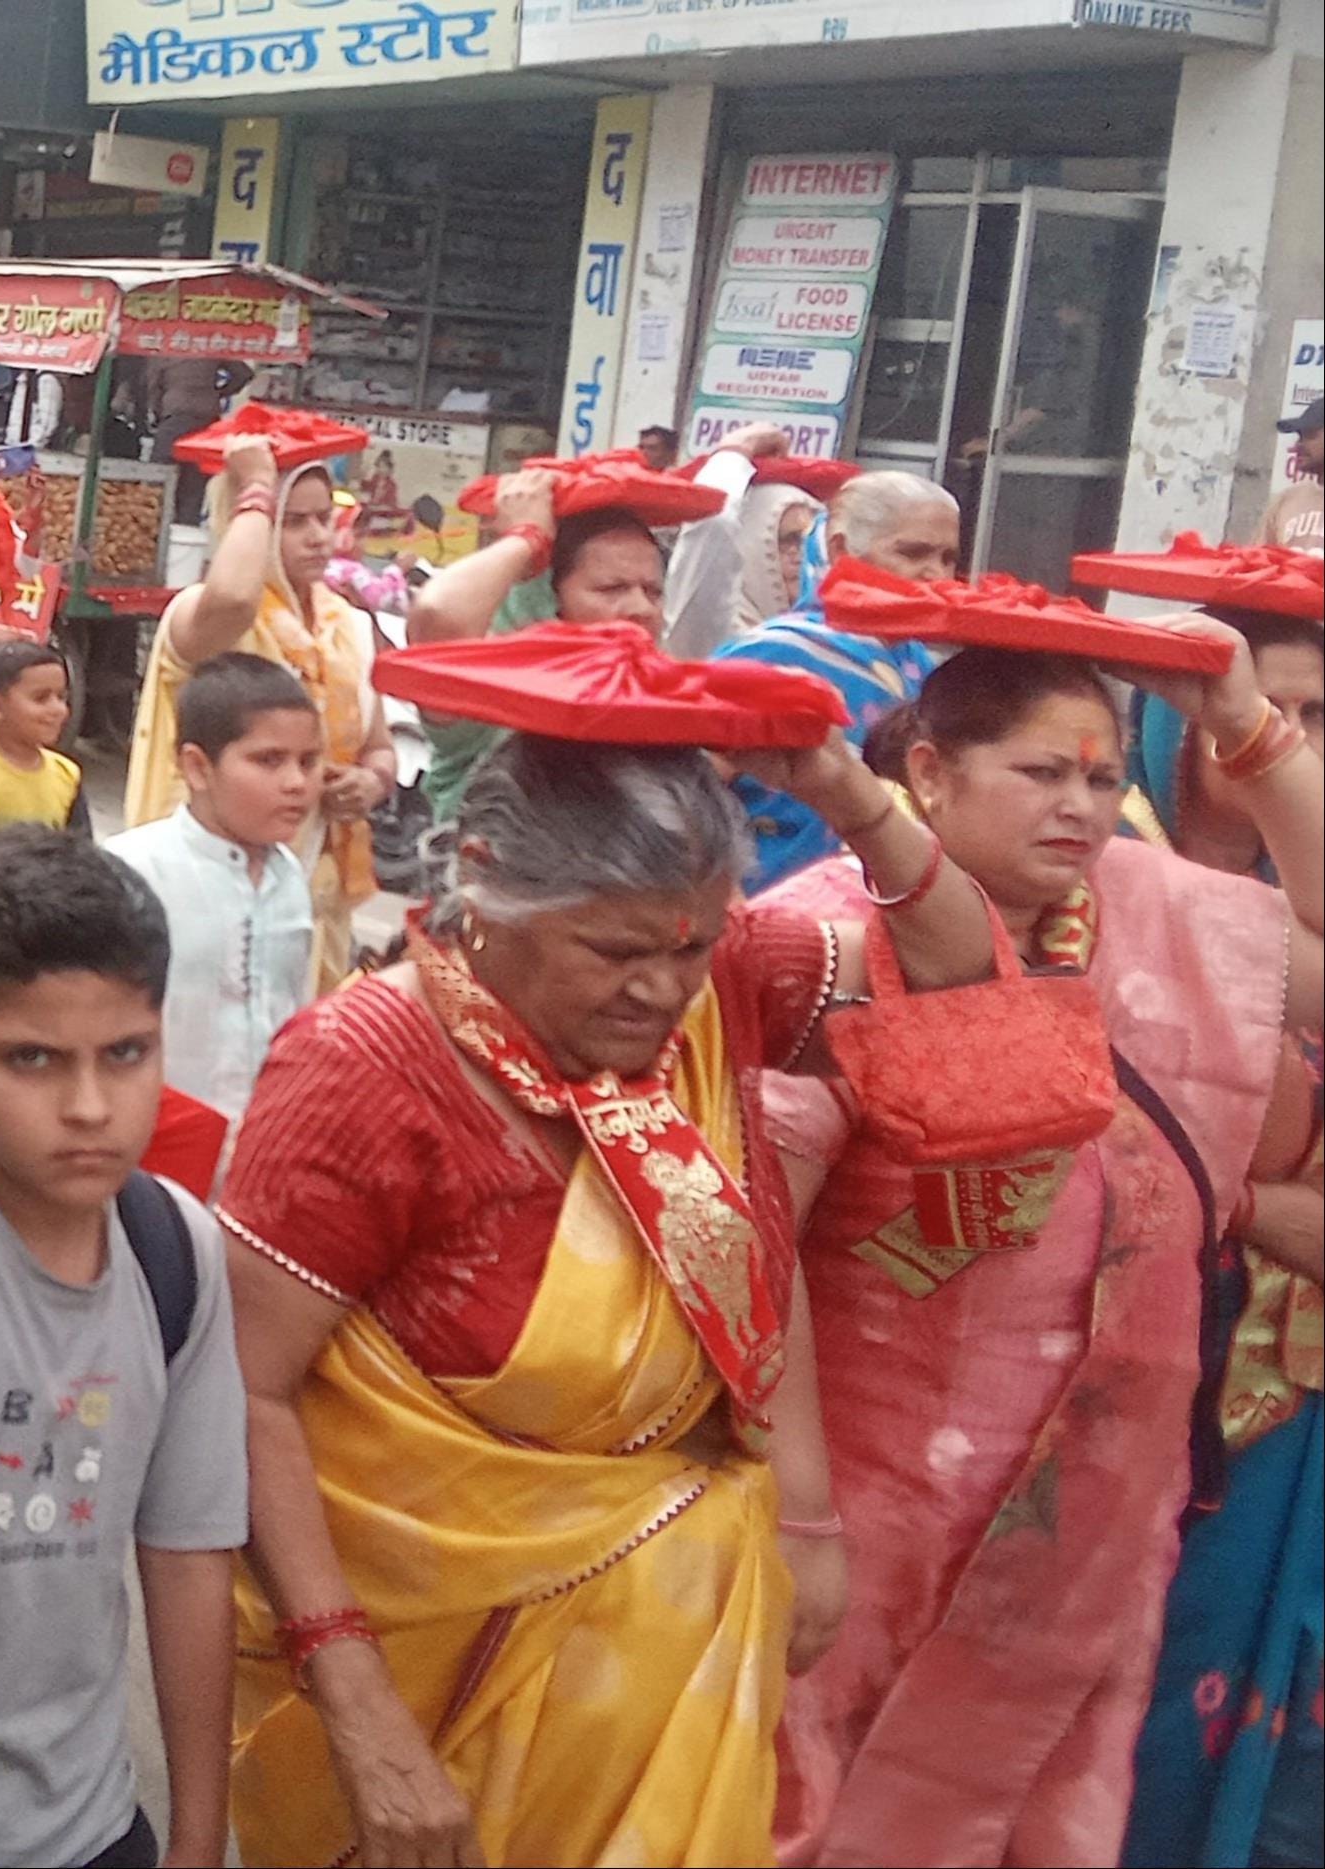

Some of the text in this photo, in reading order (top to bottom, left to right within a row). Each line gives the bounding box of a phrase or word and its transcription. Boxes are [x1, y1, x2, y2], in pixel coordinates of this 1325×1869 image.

[99, 2, 496, 84] मैडिकल स्टोर
[748, 163, 892, 195] INTERNET
[774, 223, 837, 241] URGENT
[731, 247, 871, 267] MONEY TRANSFER
[796, 287, 848, 305] FOOD
[776, 312, 858, 332] LICENSE
[746, 370, 802, 383] UDYAM
[716, 382, 828, 400] REGISTRATION
[397, 421, 451, 446] STORE
